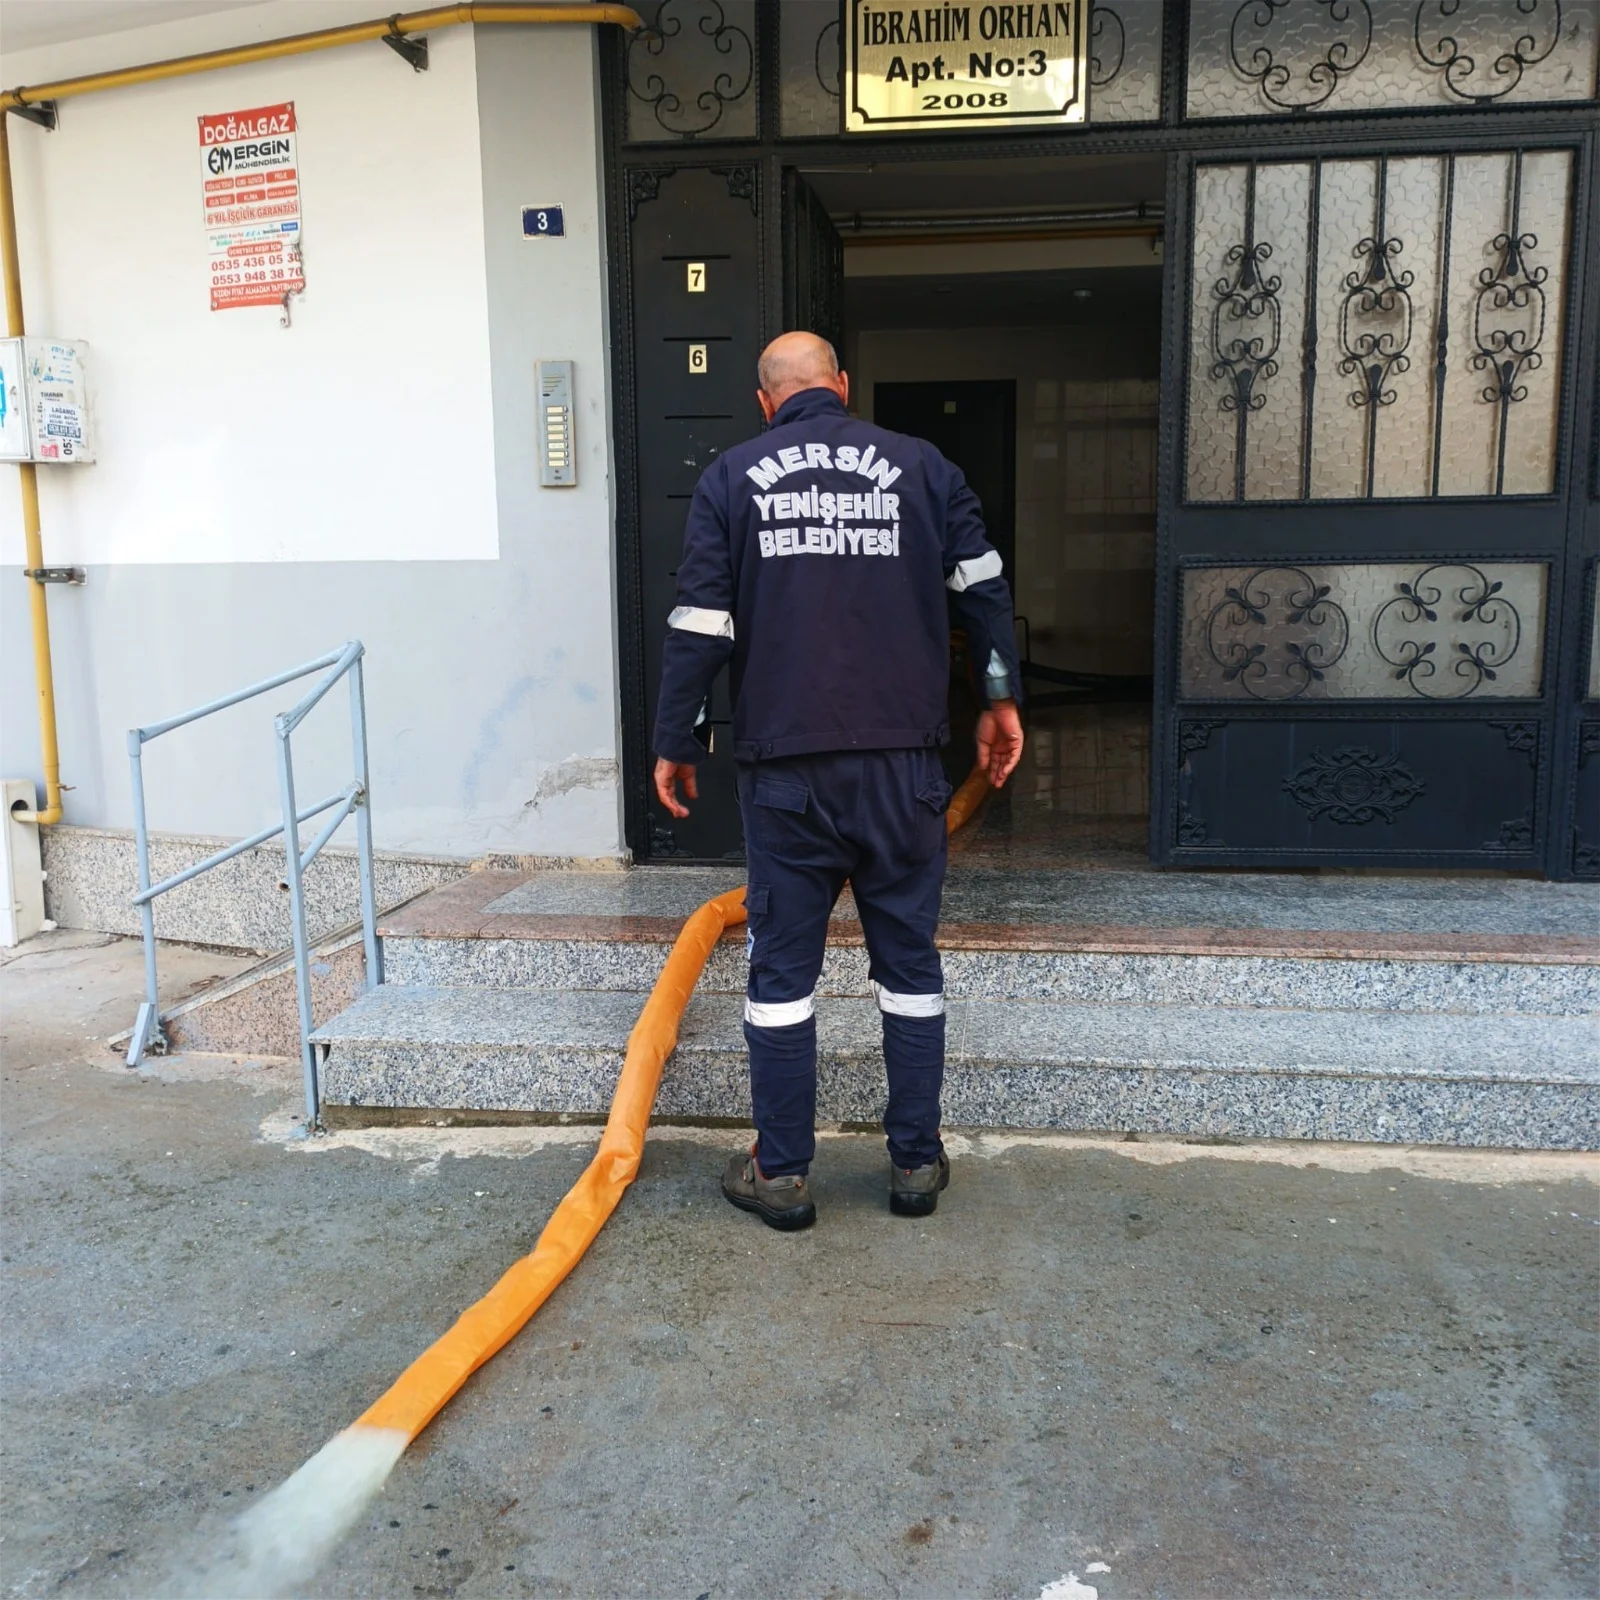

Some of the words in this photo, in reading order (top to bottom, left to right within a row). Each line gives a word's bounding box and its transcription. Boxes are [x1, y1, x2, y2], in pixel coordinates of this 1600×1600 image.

[863, 1, 970, 46] İBRAHİM
[979, 2, 1071, 41] ORHAN
[885, 55, 955, 88] Apt.
[969, 50, 1047, 79] No:3
[922, 92, 1008, 110] 2008
[203, 113, 290, 144] DOĞALGAZ
[234, 139, 290, 160] ERGİN
[537, 212, 548, 231] 3
[211, 260, 240, 272] 0535
[243, 257, 265, 268] 436
[268, 255, 283, 266] 05
[212, 274, 241, 286] 0553
[244, 271, 266, 283] 948
[270, 269, 284, 280] 38
[690, 269, 703, 287] 7
[692, 349, 704, 367] 6
[746, 443, 902, 491] MERSİN
[752, 484, 900, 525] YENİŞEHİR
[758, 520, 900, 558] BELEDİYESİ
